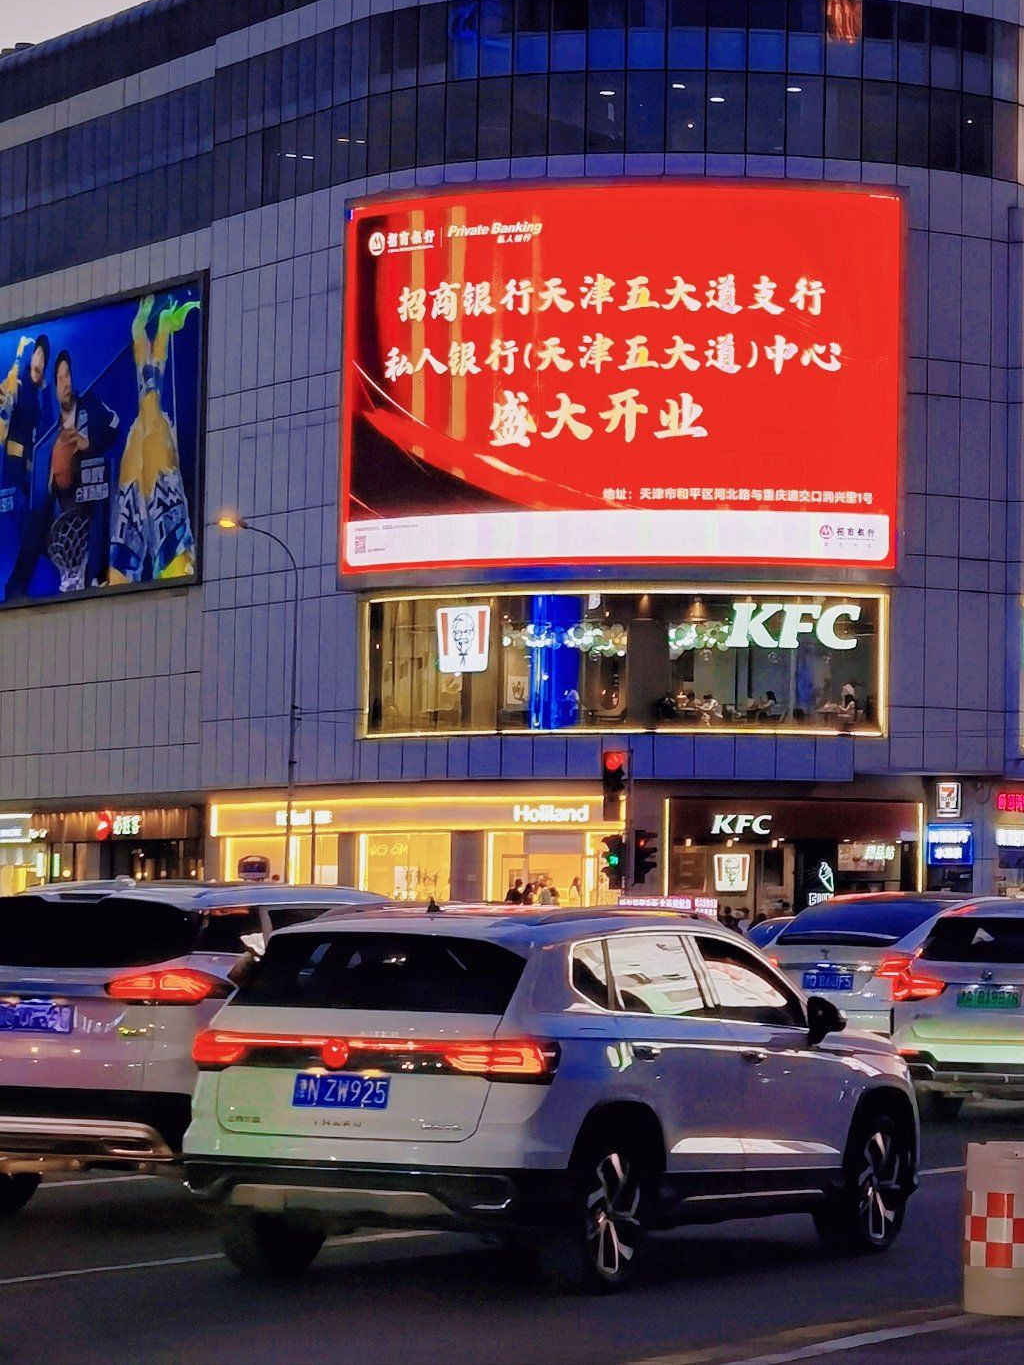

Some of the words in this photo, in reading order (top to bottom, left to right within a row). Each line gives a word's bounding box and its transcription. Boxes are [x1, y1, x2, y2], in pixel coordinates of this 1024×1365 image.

[448, 223, 490, 238] Private
[491, 221, 543, 235] Banking
[398, 273, 826, 322] 招商银行天津五大道支行
[384, 333, 842, 382] 私人银行(天津五大道)中心
[489, 388, 708, 448] 盛大开业
[726, 603, 862, 650] KFC
[711, 814, 773, 834] KFC
[324, 1078, 387, 1105] ZW925
